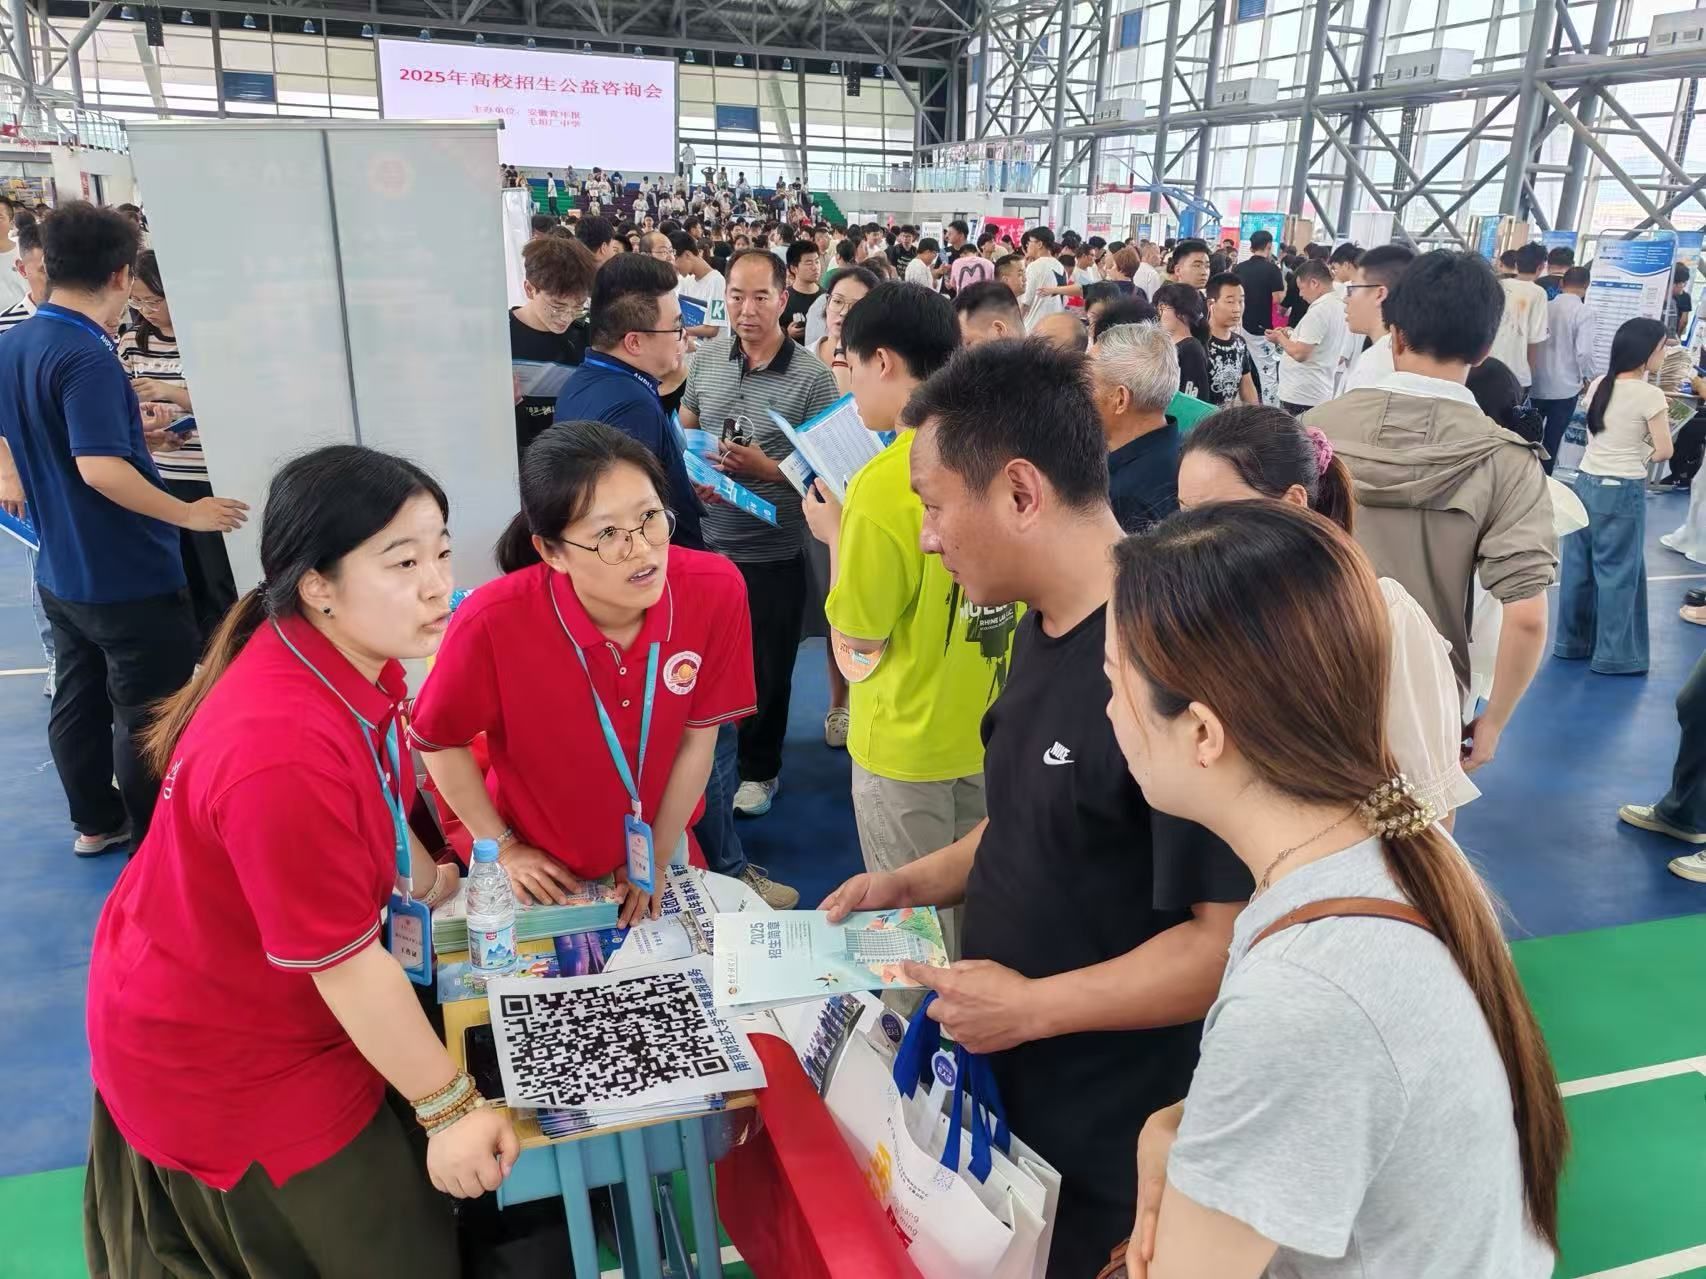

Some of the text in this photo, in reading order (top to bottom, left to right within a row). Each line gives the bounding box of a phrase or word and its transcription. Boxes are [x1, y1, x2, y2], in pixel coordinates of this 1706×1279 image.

[399, 68, 663, 99] 2025年高校招生公益咨询会
[750, 921, 766, 946] 2025
[767, 920, 783, 960] 招生简章
